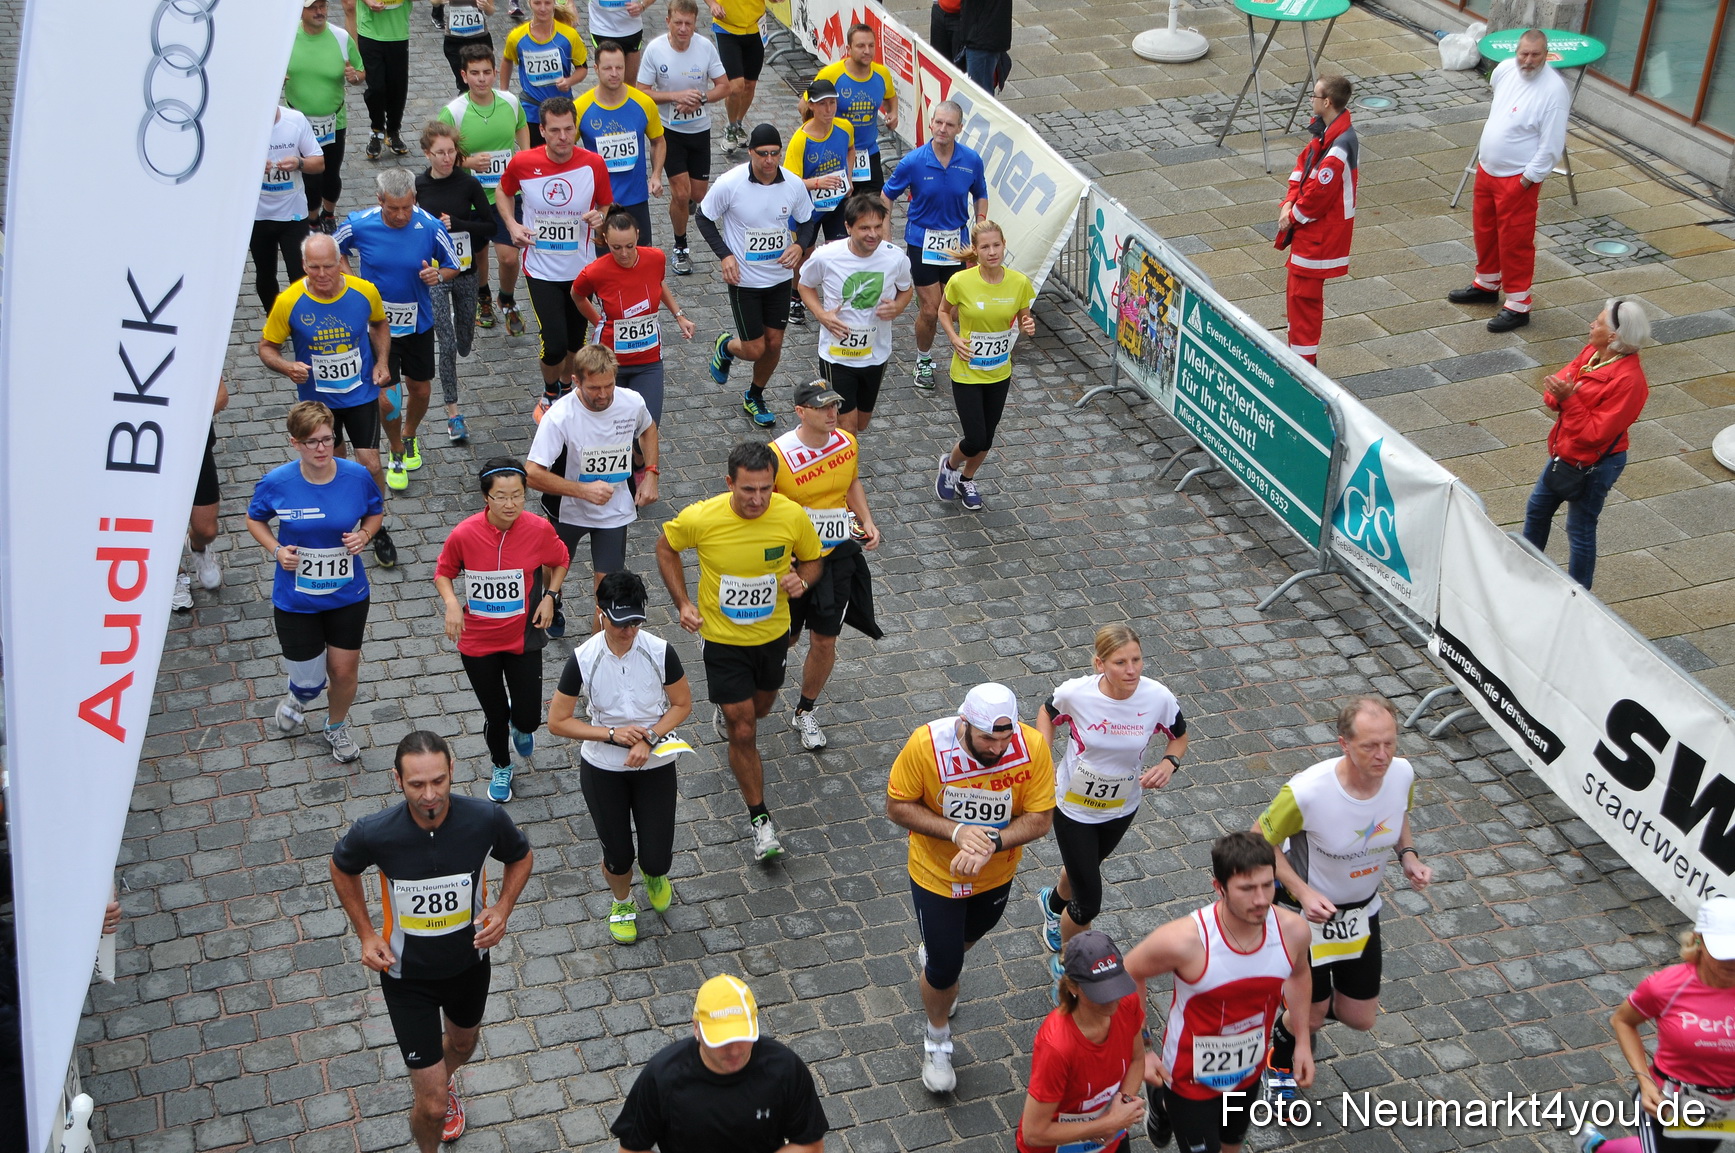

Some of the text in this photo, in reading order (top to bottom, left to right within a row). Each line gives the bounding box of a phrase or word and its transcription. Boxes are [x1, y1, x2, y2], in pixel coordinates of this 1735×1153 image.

[453, 13, 481, 27] 2764
[527, 58, 559, 74] 2736
[602, 142, 636, 160] 2795
[538, 226, 574, 240] 2901
[749, 235, 784, 251] 2293
[619, 320, 654, 340] 2645
[840, 333, 868, 348] 254
[974, 339, 1009, 356] 2733
[1206, 321, 1275, 389] Event-Leit-Systeme
[318, 360, 358, 379] 3301
[1184, 342, 1275, 438] Mehr Sicherheit
[1181, 368, 1257, 451] für Ihr Event!
[585, 454, 628, 473] 3374
[795, 448, 856, 486] MAX BÖGL
[1179, 404, 1289, 514] Miet & Service Line: 09181 6352
[78, 266, 185, 744] Audi BKK
[812, 520, 845, 538] 780
[302, 558, 348, 577] 2118
[1336, 535, 1364, 566] Gebäude
[1366, 557, 1390, 583] Service
[1390, 576, 1412, 599] GmbH
[311, 581, 338, 589] Sophia
[471, 582, 520, 600] 2088
[722, 579, 768, 588] PARTL Neumarkt
[725, 588, 772, 606] 2282
[486, 604, 506, 612] Chen
[736, 610, 760, 618] Albert
[1483, 682, 1500, 702] die
[1500, 697, 1549, 752] verbinden
[990, 770, 1032, 791] BÖGL
[1077, 766, 1096, 780] PARTL
[946, 790, 1002, 802] PARTL Neumarkt
[1084, 782, 1120, 798] 131
[950, 800, 1006, 821] 2599
[1083, 798, 1107, 808] Heike
[396, 882, 458, 893] PARTL Neumarkt
[412, 891, 459, 914] 288
[426, 918, 447, 928] Jimi
[1322, 917, 1360, 940] 602
[1222, 1037, 1254, 1048] Neumarkt
[1202, 1044, 1259, 1072] 2217
